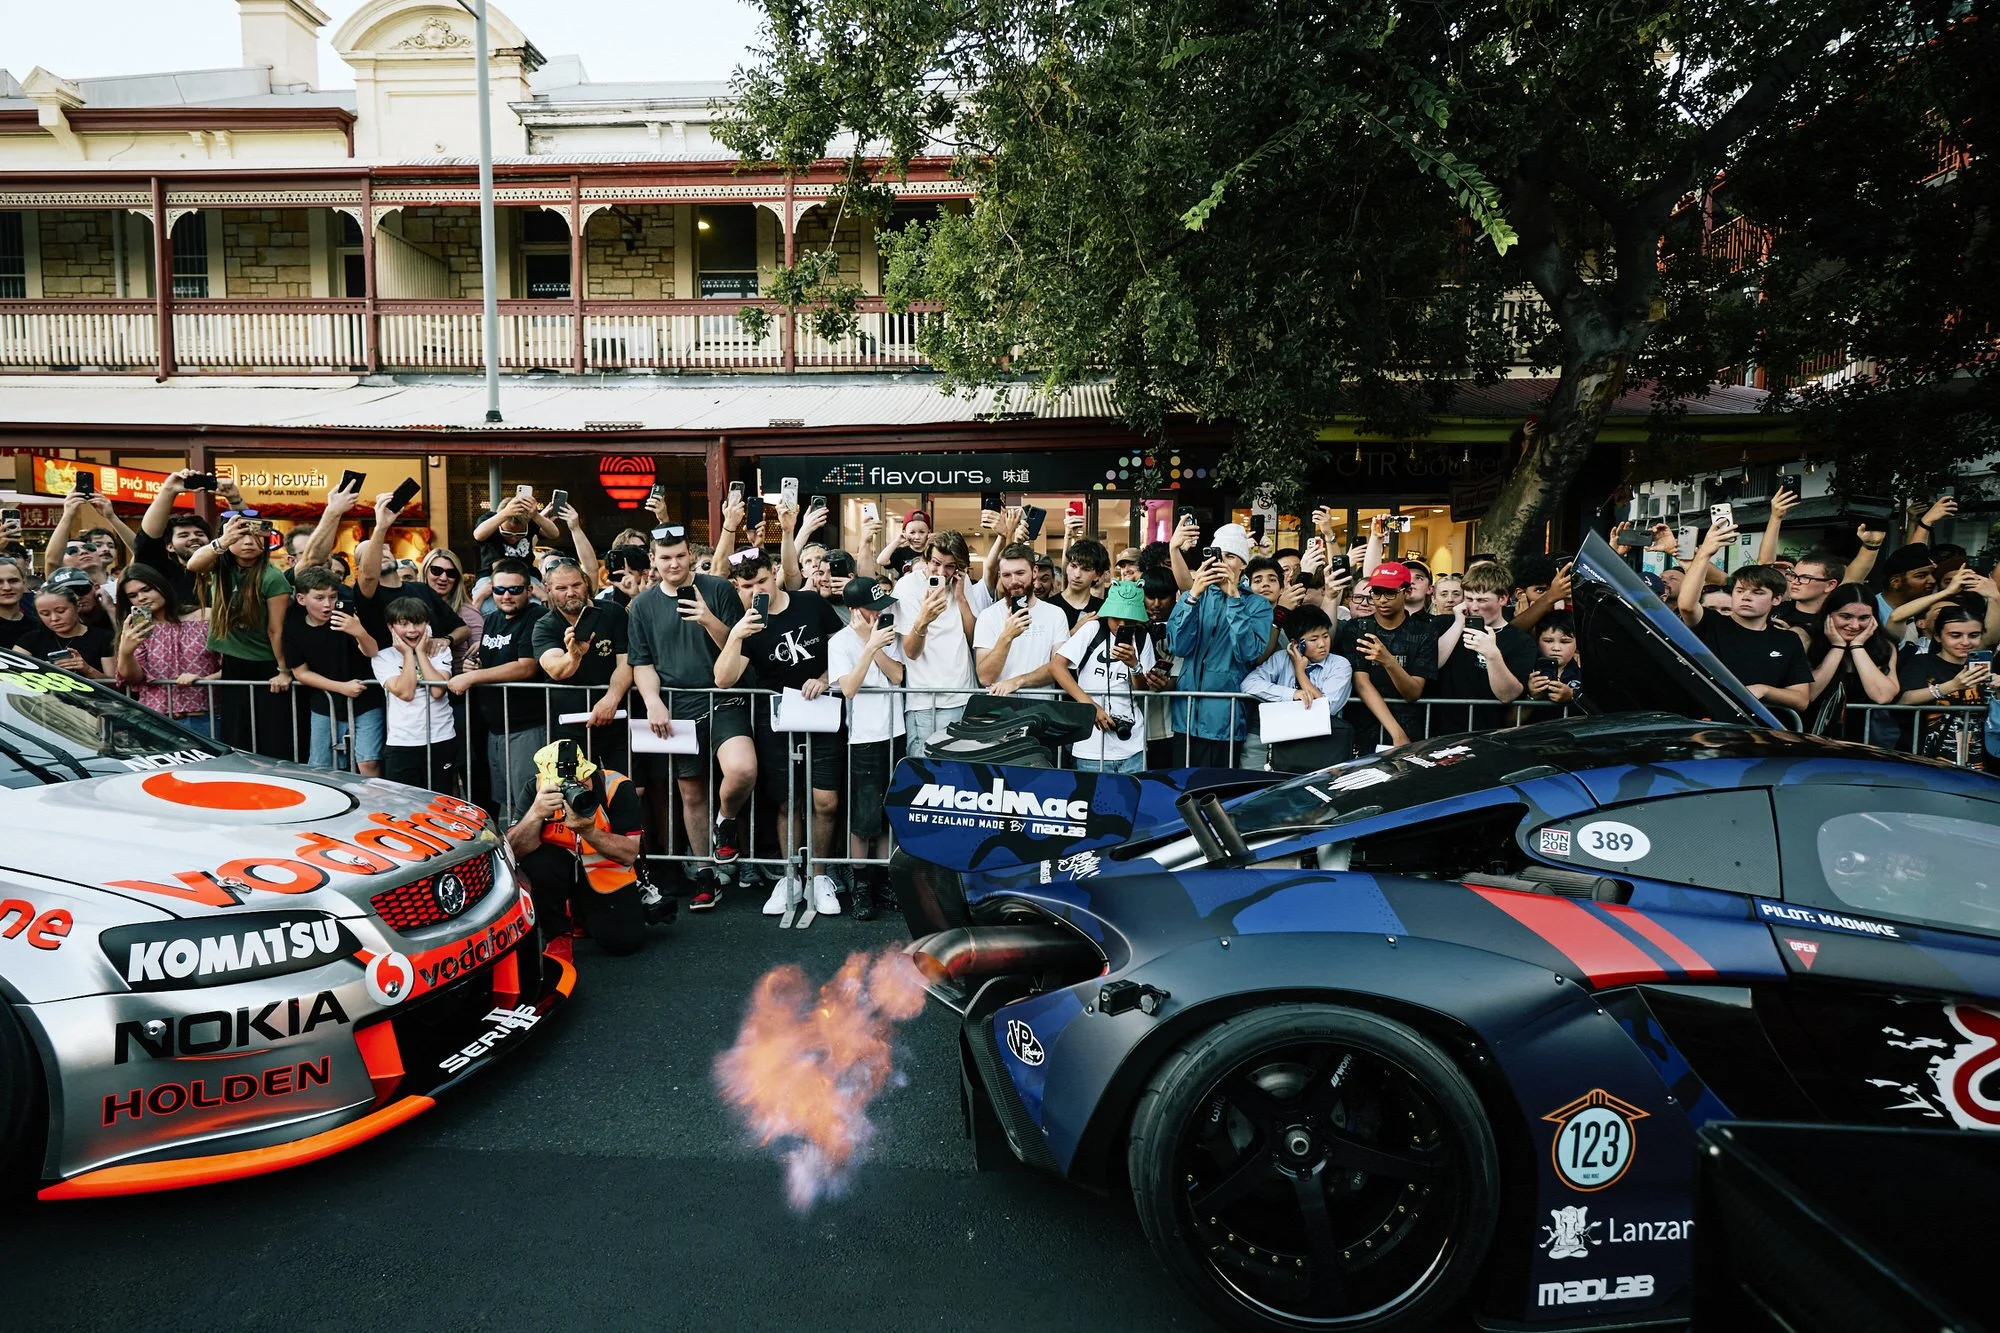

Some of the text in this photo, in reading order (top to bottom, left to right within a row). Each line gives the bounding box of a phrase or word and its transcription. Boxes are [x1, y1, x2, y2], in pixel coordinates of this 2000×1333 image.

[1002, 468, 1030, 484] 味道
[1094, 667, 1128, 681] AIR
[121, 748, 217, 772] NOKIA
[911, 778, 1089, 820] MadMac
[554, 823, 564, 834] 19
[908, 813, 929, 823] NEW
[932, 815, 975, 827] ZEALAND
[979, 818, 1005, 830] MADE
[1542, 832, 1569, 843] RUN
[1542, 840, 1568, 852] 20B
[1592, 831, 1634, 852] 389
[1761, 904, 1901, 938] PILOT: MADMIKE
[128, 919, 341, 983] KOMATSU
[418, 915, 525, 987] vodafone
[1790, 941, 1817, 953] OPEN
[114, 990, 350, 1065] NOKIA
[102, 1056, 331, 1127] HOLDEN
[1569, 1120, 1621, 1169] 123
